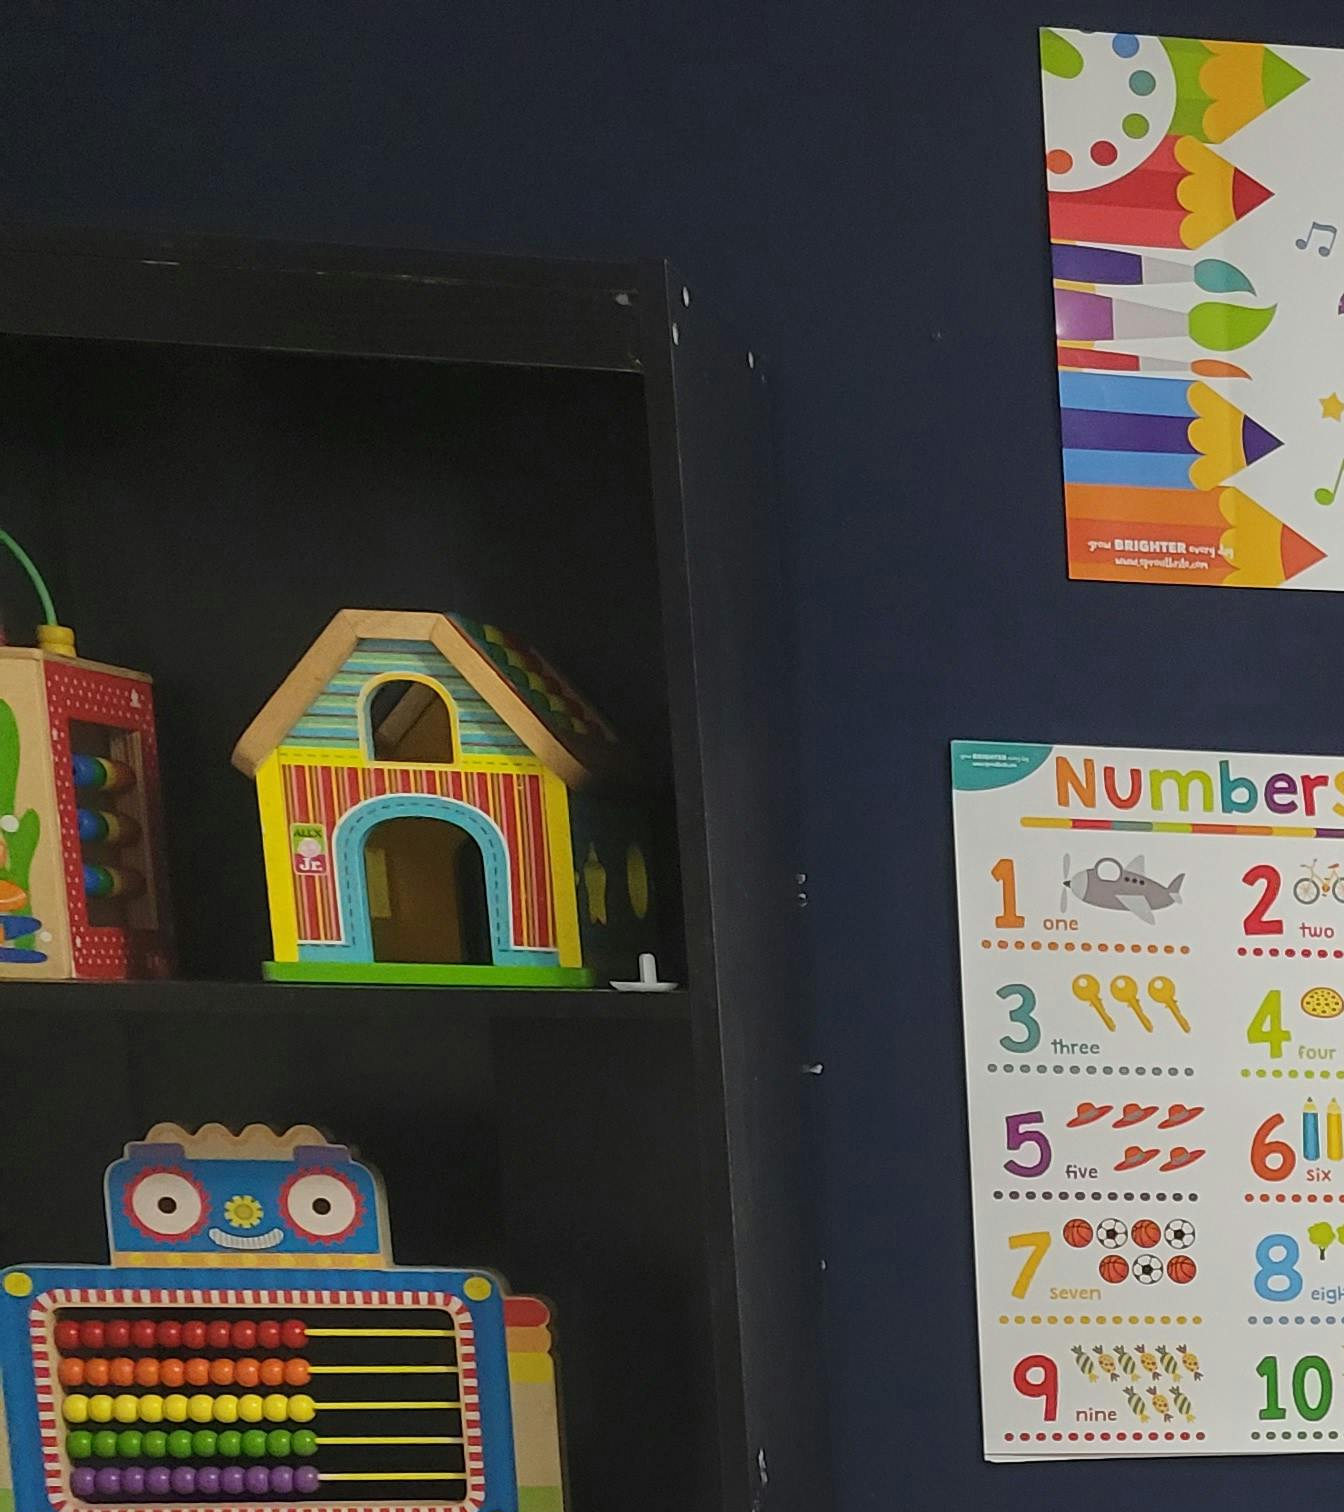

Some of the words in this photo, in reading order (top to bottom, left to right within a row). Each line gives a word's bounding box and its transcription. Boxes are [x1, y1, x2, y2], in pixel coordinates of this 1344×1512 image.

[1087, 539, 1112, 552] grow
[1114, 539, 1187, 554] BRIGHTER
[1188, 545, 1215, 558] every
[991, 859, 1025, 928] 1
[1043, 916, 1079, 932] one
[1242, 865, 1283, 935] 2
[1299, 923, 1334, 938] two
[996, 984, 1041, 1053] 3
[1051, 1039, 1099, 1054] three
[1247, 990, 1291, 1059] 4
[1298, 1045, 1336, 1059] four
[1004, 1111, 1051, 1177] 5
[1066, 1165, 1097, 1179] five
[1251, 1113, 1296, 1181] 6
[1307, 1168, 1331, 1181] six
[1008, 1230, 1052, 1300] 7
[1050, 1288, 1101, 1300] seven
[1254, 1234, 1303, 1302] 8
[1013, 1355, 1058, 1421] 9
[1076, 1408, 1116, 1421] nine
[1256, 1356, 1332, 1421] 10
